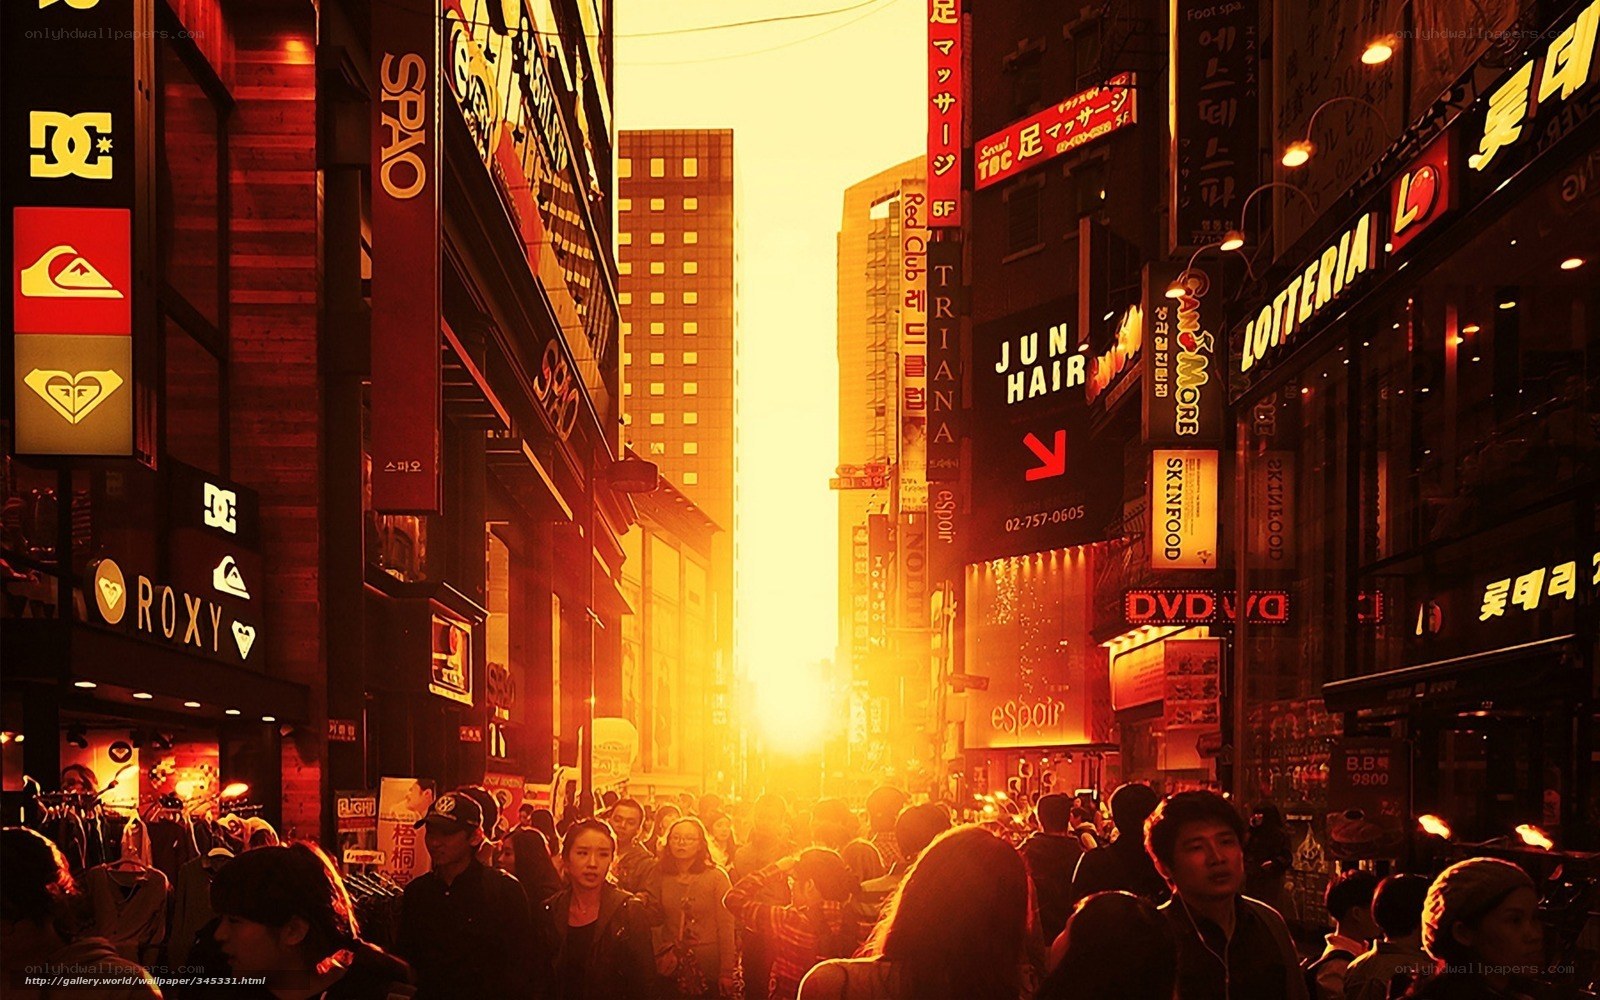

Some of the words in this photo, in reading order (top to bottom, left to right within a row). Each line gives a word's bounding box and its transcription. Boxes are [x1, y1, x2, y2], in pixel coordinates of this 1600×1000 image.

[380, 53, 427, 199] SPAO
[905, 193, 926, 229] Red
[932, 200, 956, 218] 5F
[905, 236, 927, 281] Club
[1241, 213, 1369, 372] LOTTERIA
[905, 290, 926, 410] 레드클럽
[933, 265, 954, 443] TRIANA
[995, 322, 1068, 374] JUN
[1007, 354, 1086, 405] HAIR
[384, 461, 422, 473] 스파오
[1005, 505, 1085, 532] 02-757-0605
[1165, 457, 1183, 561] SKINFOOD
[138, 575, 222, 652] ROXY
[1128, 593, 1215, 619] DVD
[1352, 772, 1389, 786] 9800
